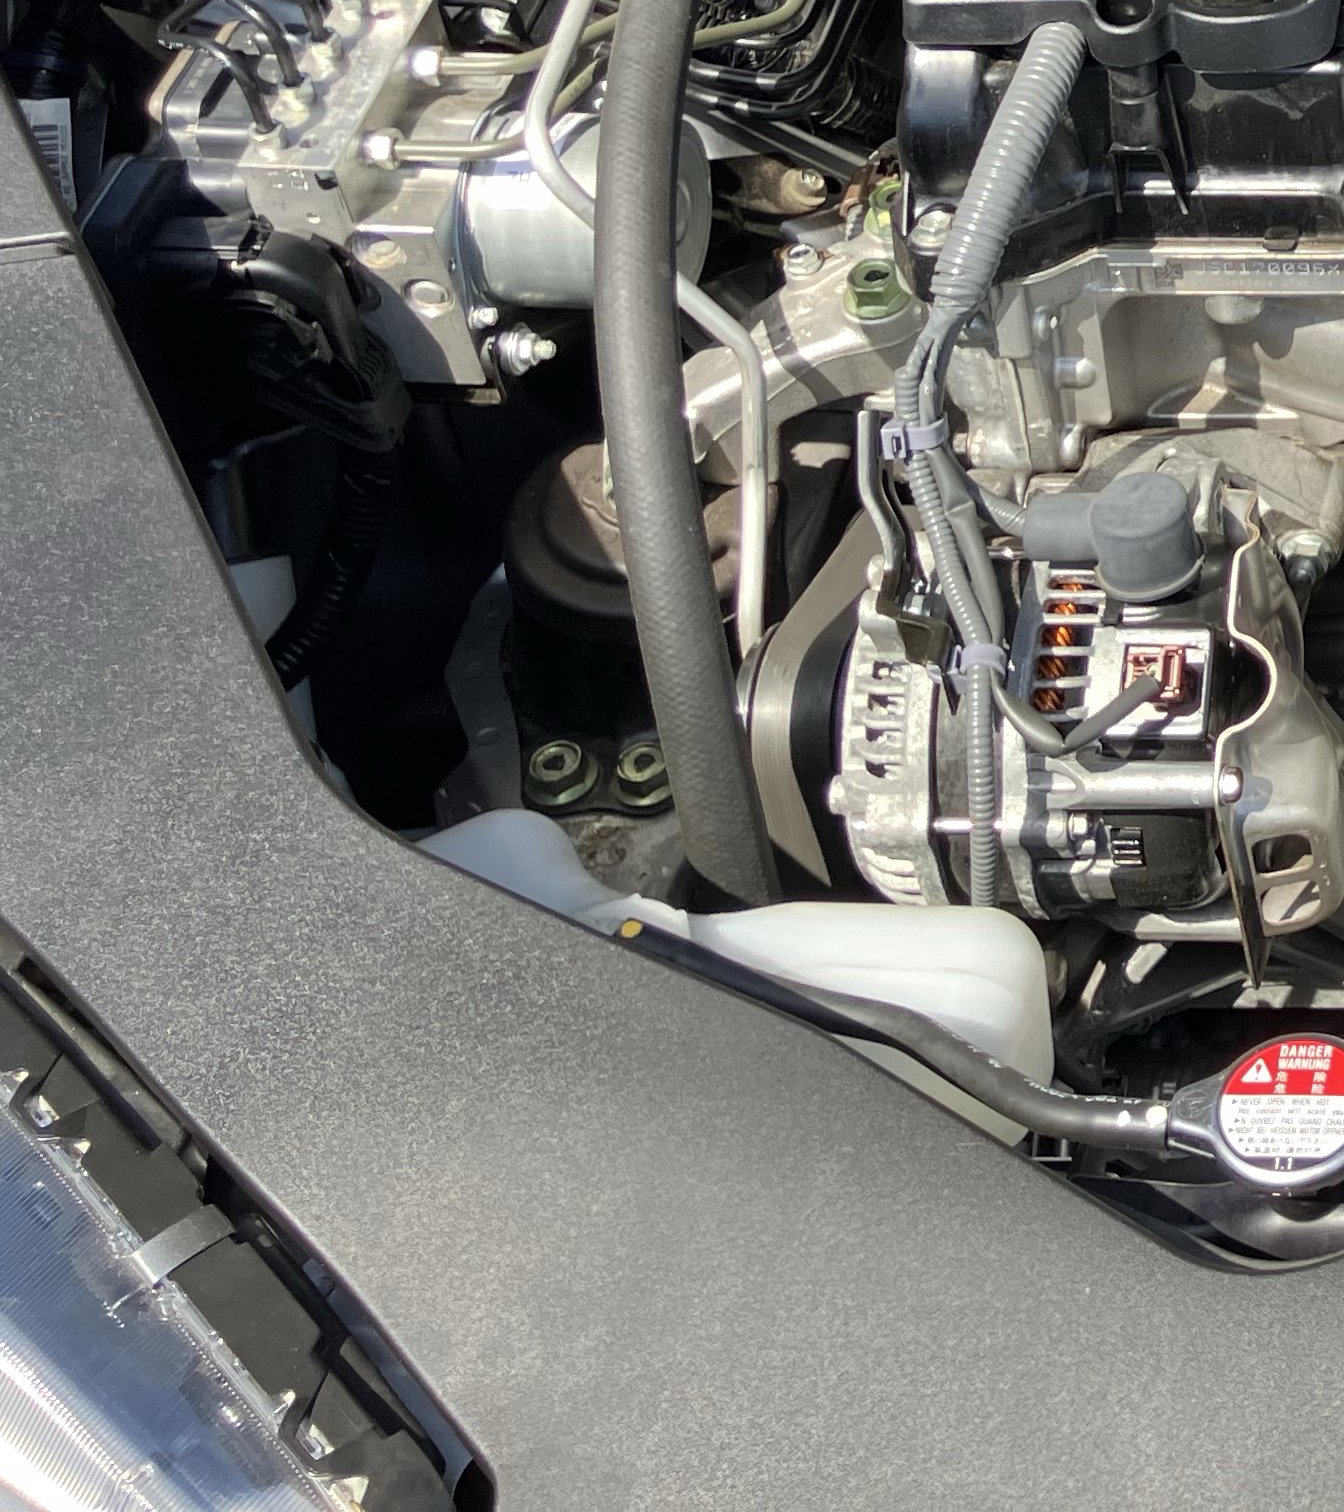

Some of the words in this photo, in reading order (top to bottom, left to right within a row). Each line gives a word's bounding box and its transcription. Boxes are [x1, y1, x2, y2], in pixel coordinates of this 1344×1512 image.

[1280, 1044, 1333, 1058] DANGER
[1278, 1058, 1331, 1070] WARNUNG
[1240, 1098, 1261, 1106] NEVER
[1268, 1098, 1285, 1106] OPEN
[1292, 1098, 1311, 1106] WHEN
[1281, 1117, 1294, 1125] PAS
[1274, 1157, 1293, 1170] 1.1
